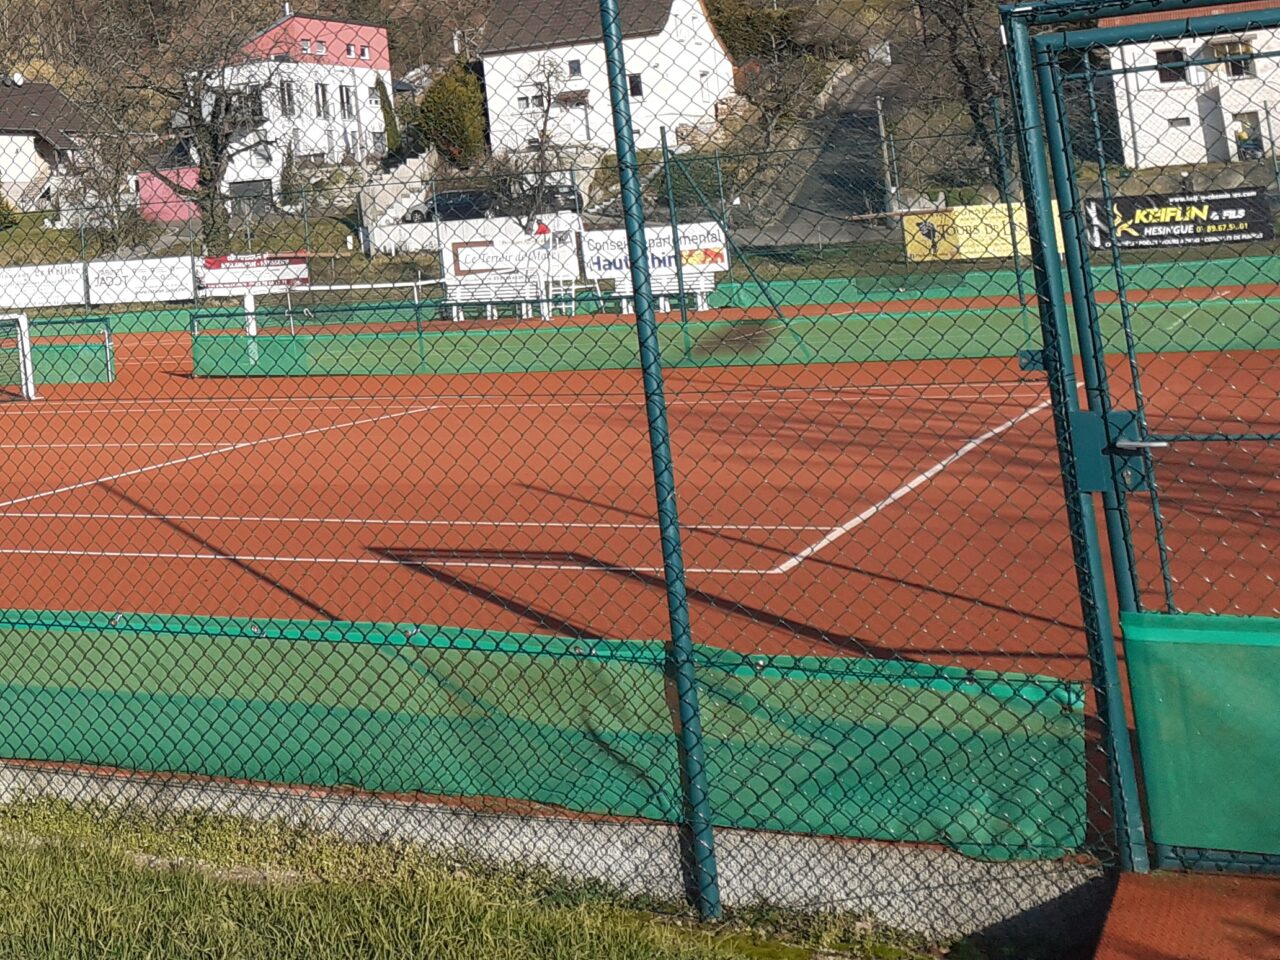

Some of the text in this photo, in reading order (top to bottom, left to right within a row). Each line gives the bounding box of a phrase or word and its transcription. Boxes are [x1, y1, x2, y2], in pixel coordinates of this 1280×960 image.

[1222, 209, 1246, 220] FILS
[1144, 224, 1195, 237] HESINGUE
[587, 237, 628, 252] Consei
